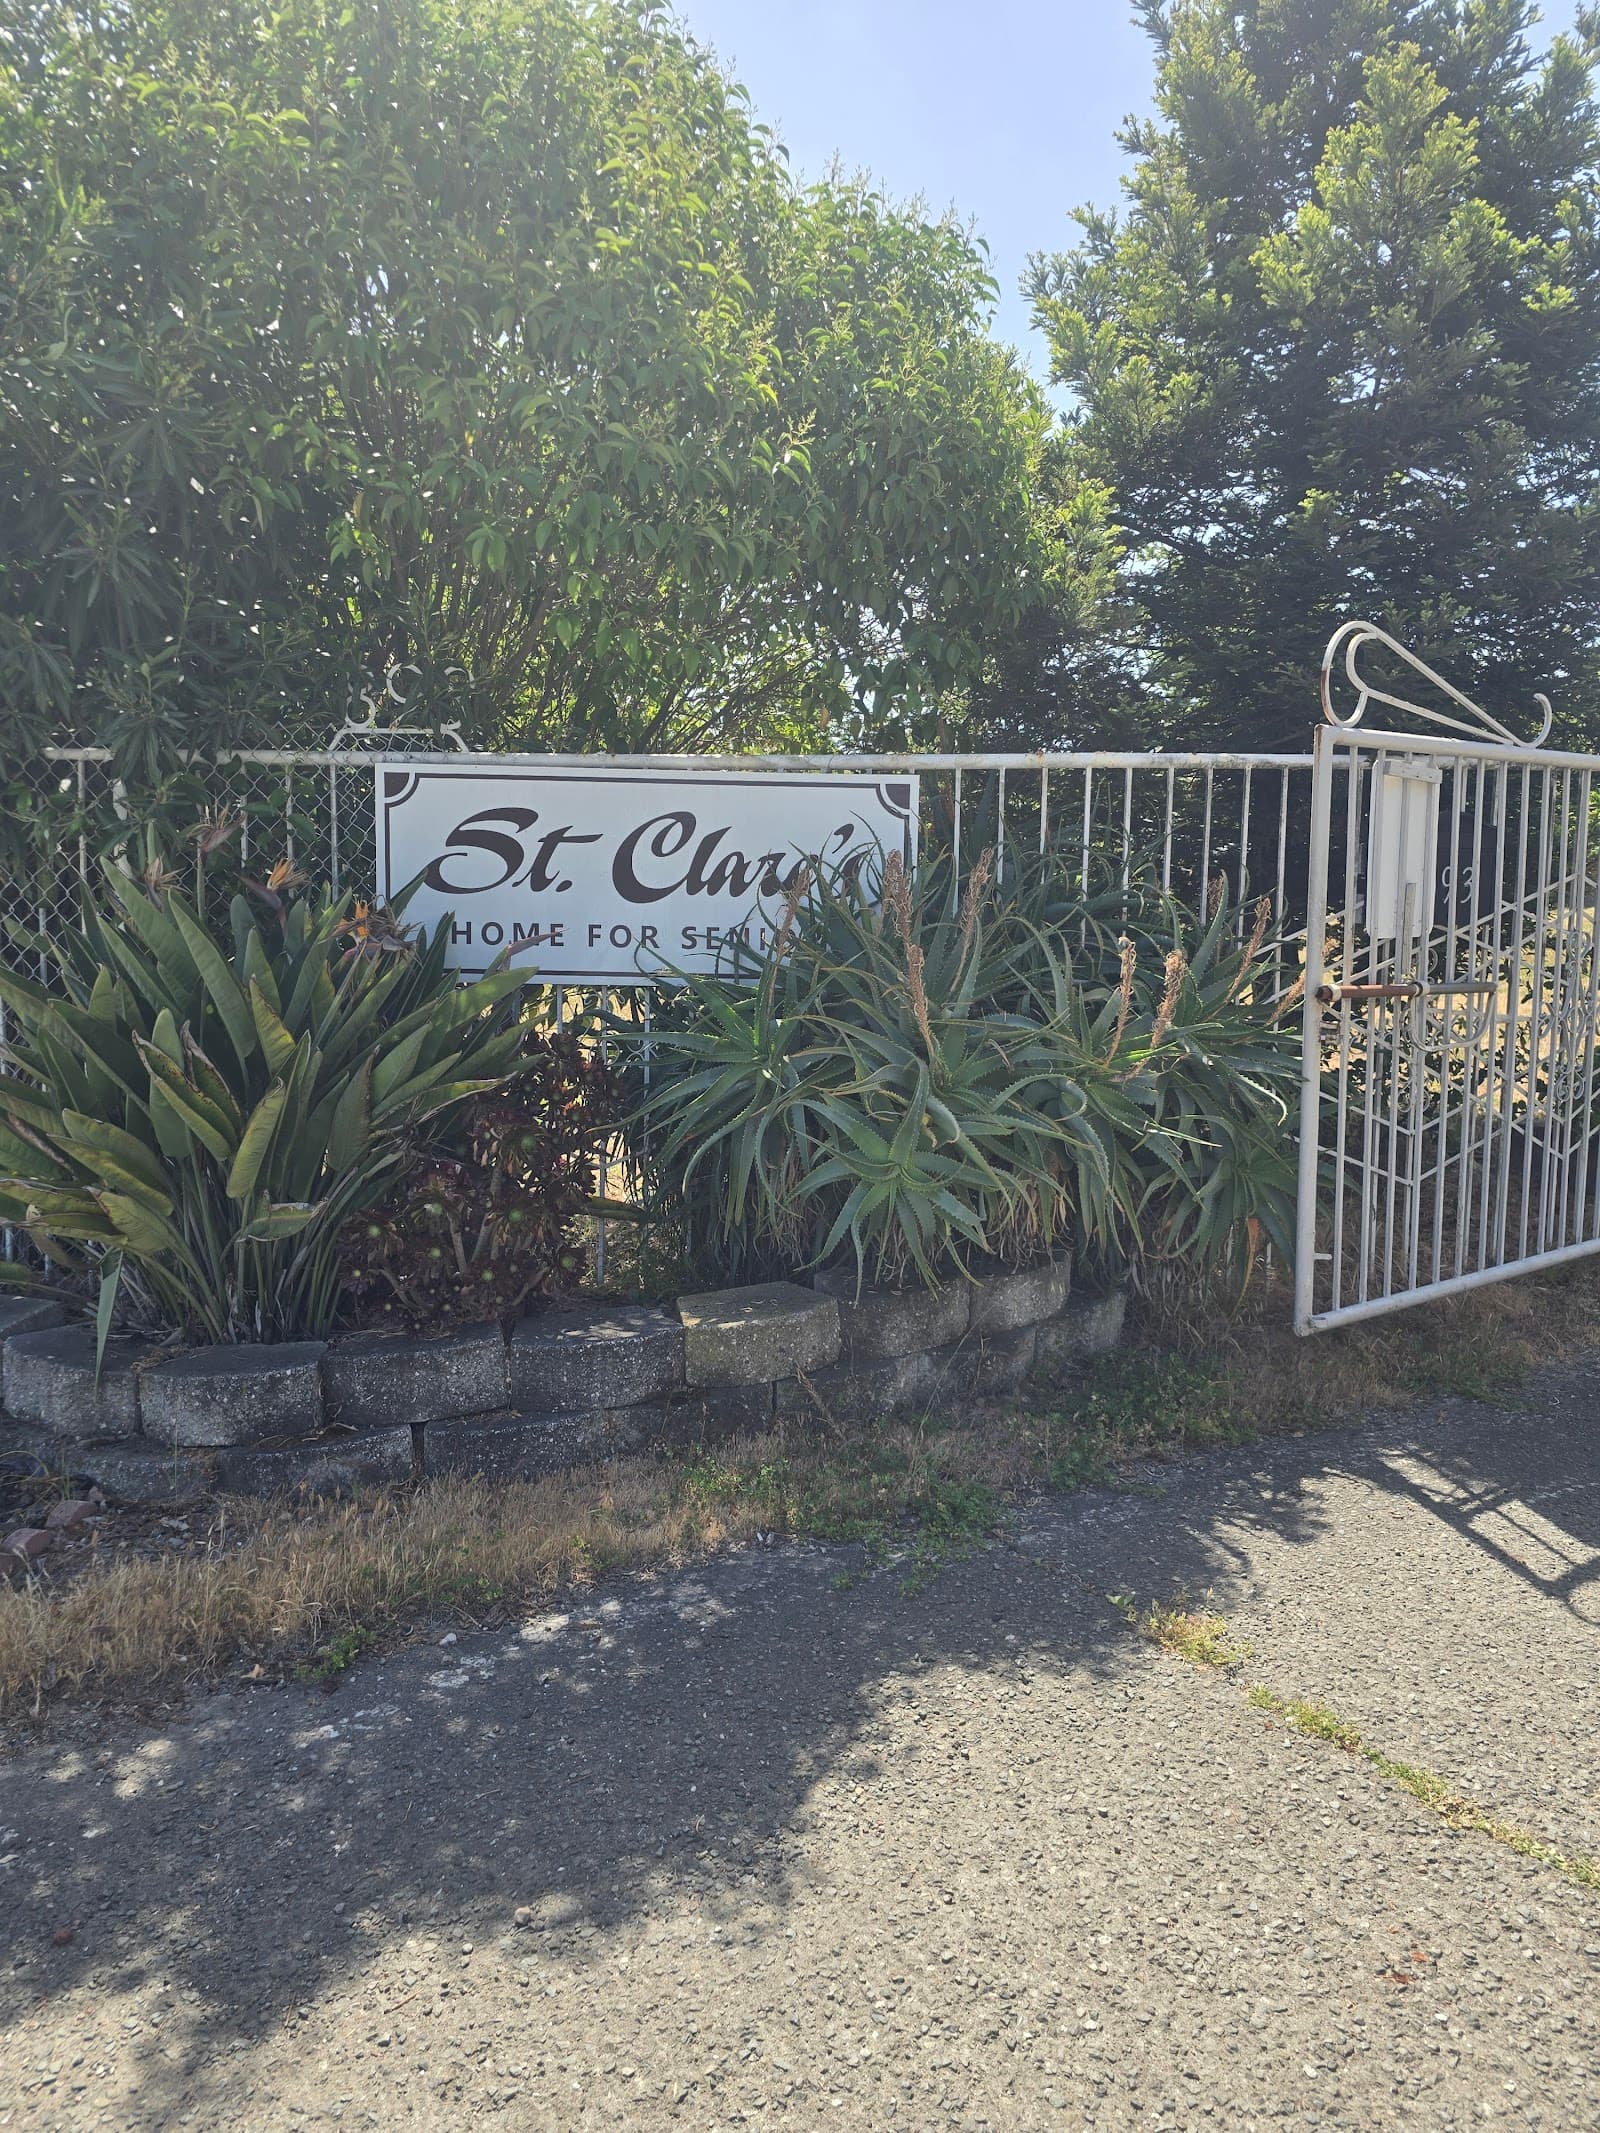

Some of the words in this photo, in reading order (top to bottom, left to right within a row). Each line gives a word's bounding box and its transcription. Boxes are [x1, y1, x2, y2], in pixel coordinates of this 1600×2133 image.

[423, 806, 604, 895] St.
[451, 921, 565, 947] HOME
[587, 924, 660, 949] FOR
[681, 926, 800, 951] SENI
